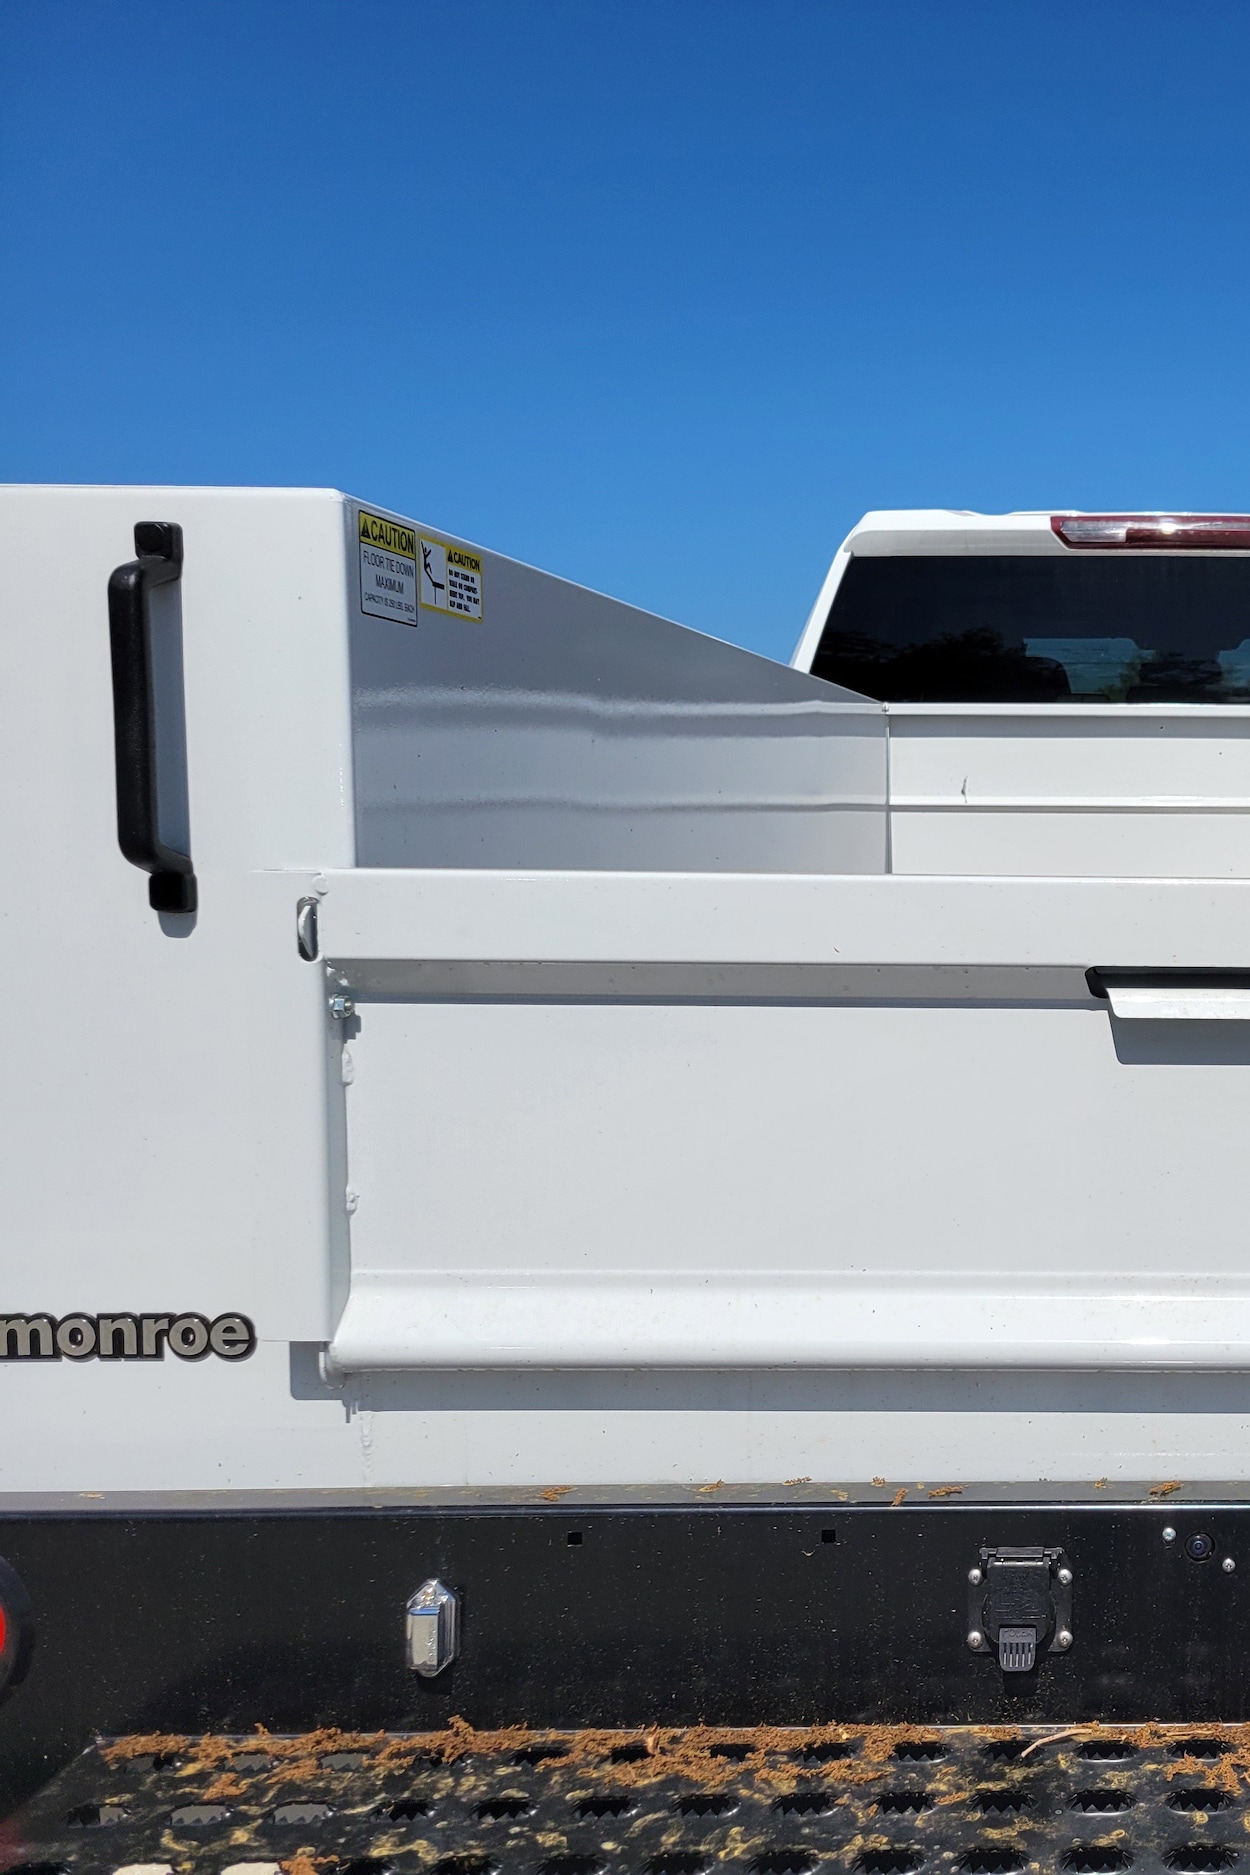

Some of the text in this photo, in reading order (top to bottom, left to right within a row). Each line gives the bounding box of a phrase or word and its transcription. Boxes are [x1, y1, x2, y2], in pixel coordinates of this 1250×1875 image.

[370, 520, 414, 554] CAUTION
[363, 550, 414, 579] FLOOR TIE DOWN
[453, 551, 480, 572] CAUTION
[375, 574, 404, 595] MAXIMUM
[364, 591, 383, 605] CAPACITY
[0, 1312, 255, 1360] monroe
